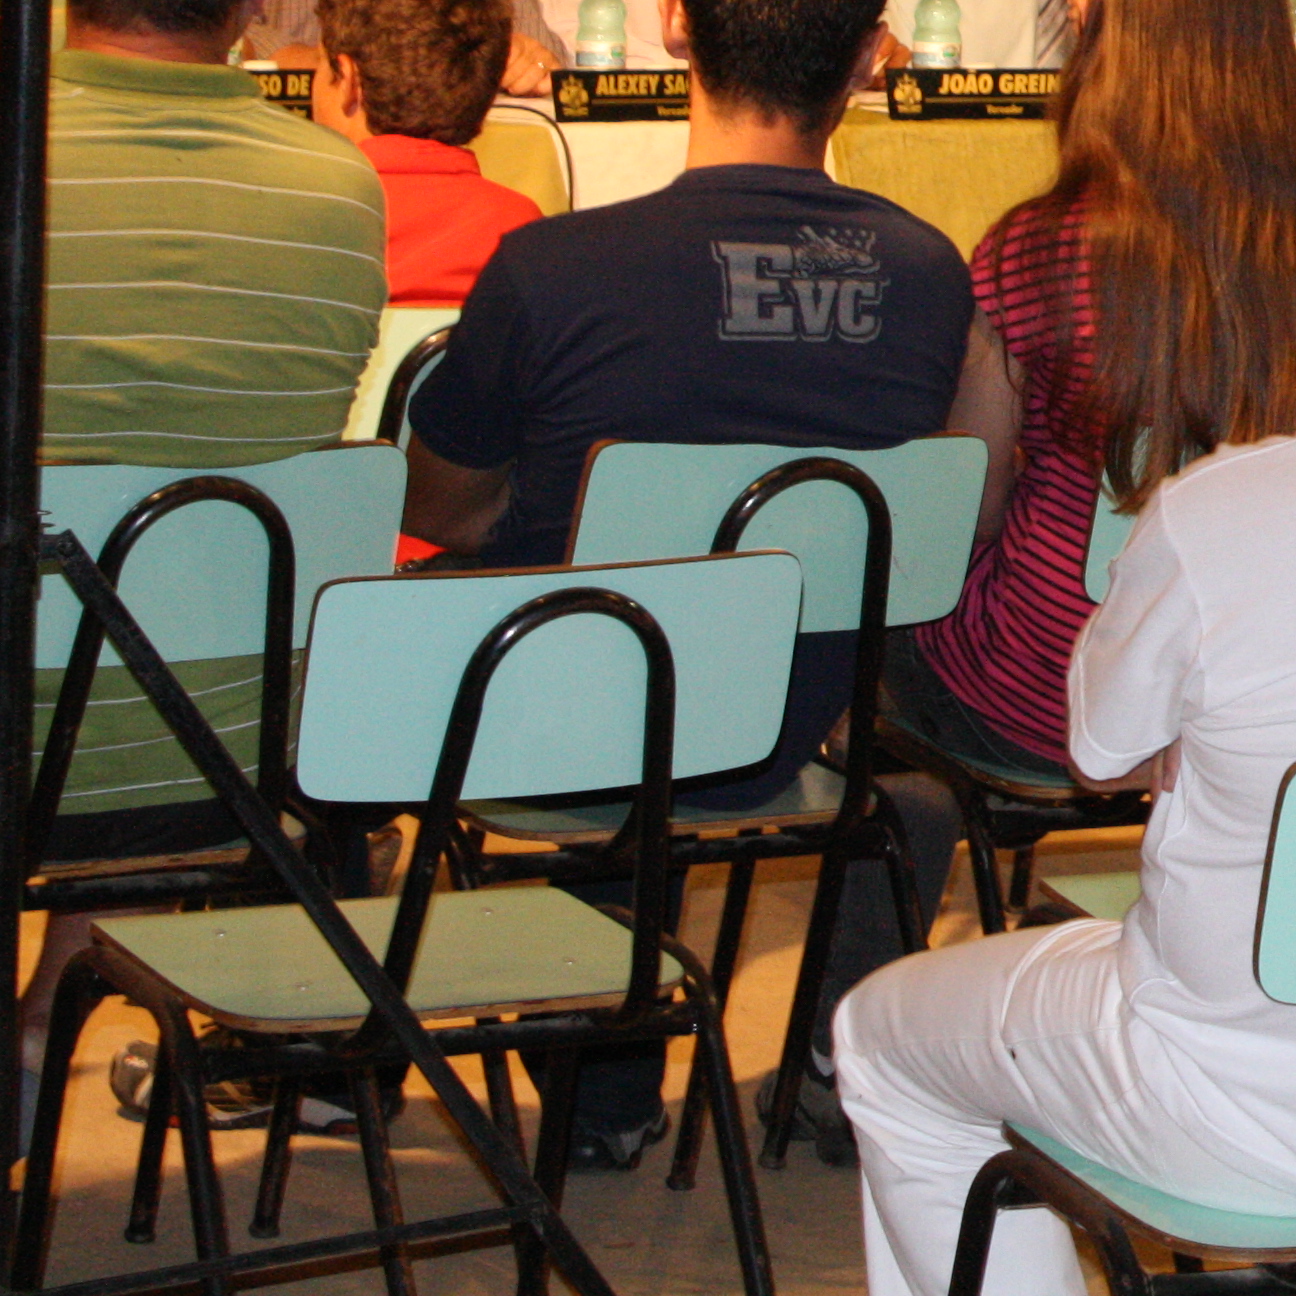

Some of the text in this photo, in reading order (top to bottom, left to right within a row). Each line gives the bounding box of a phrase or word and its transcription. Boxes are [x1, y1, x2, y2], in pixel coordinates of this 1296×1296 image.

[286, 74, 310, 96] DE
[596, 74, 659, 95] ALEXEY
[938, 69, 993, 95] JOÃO
